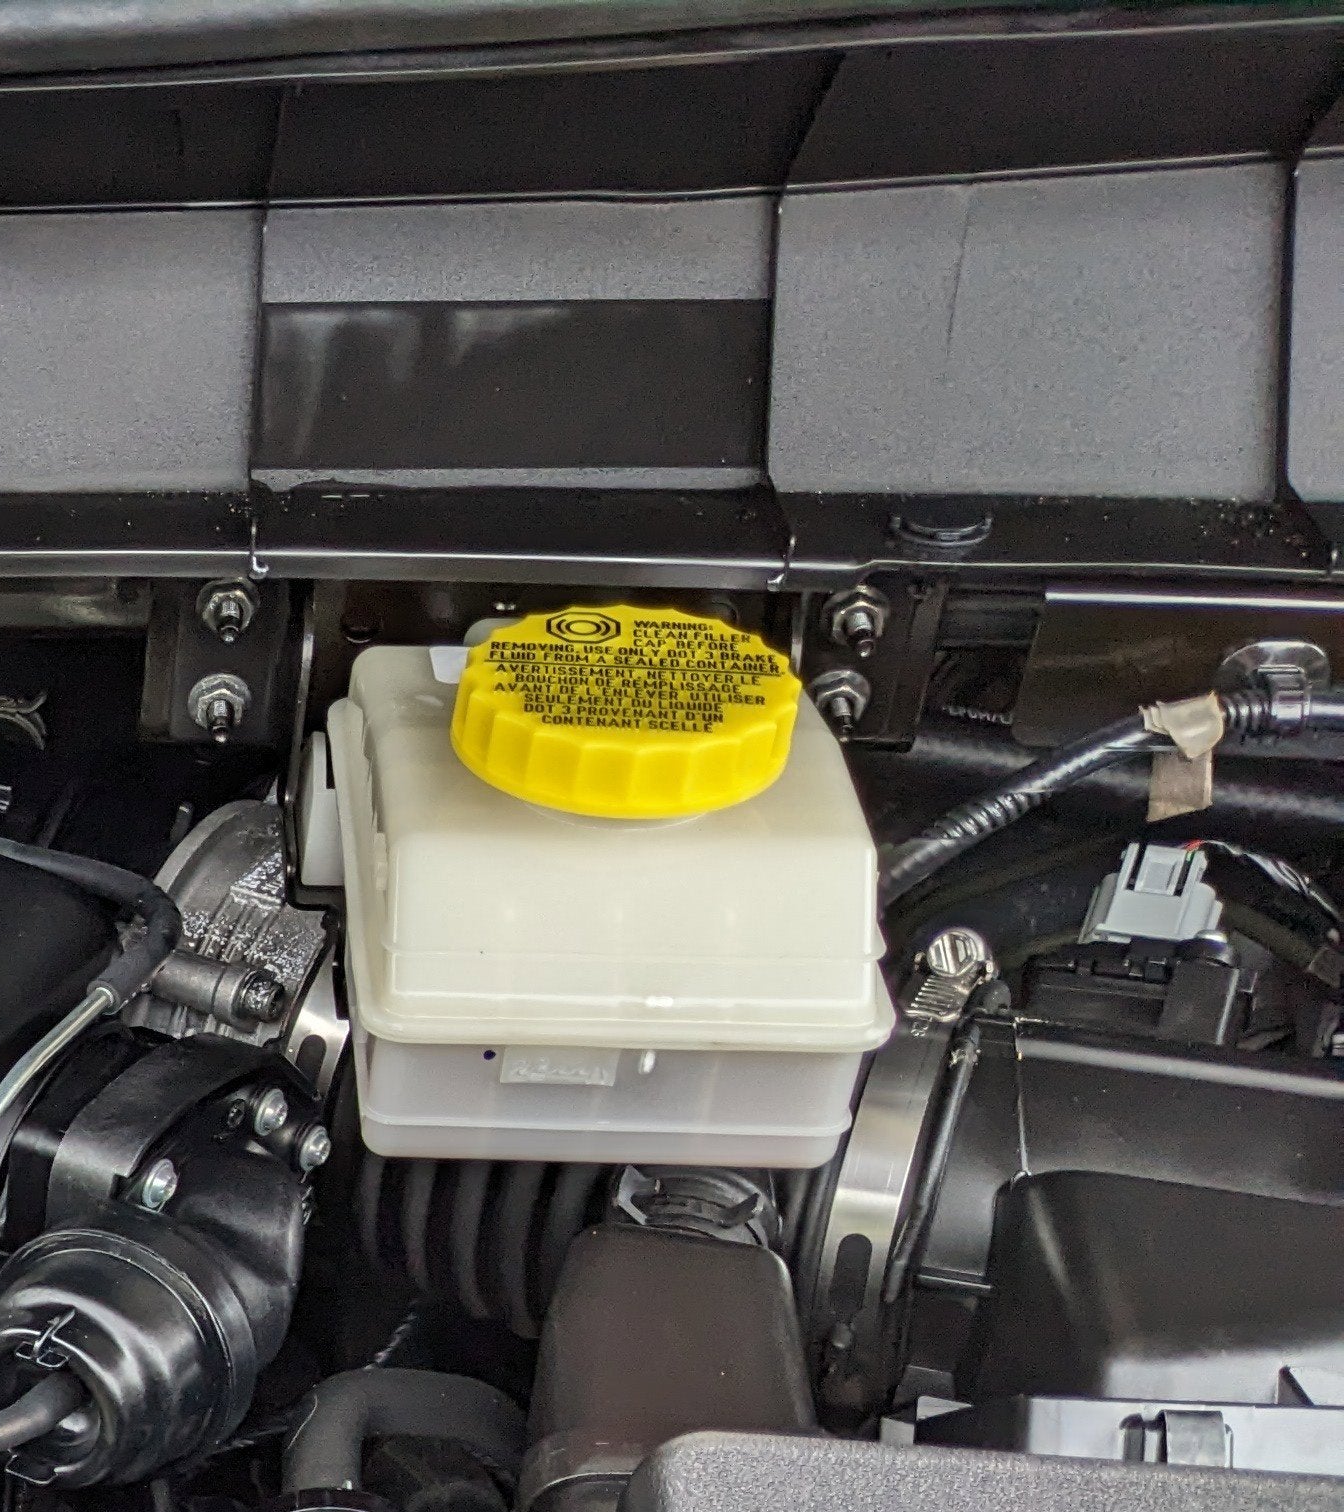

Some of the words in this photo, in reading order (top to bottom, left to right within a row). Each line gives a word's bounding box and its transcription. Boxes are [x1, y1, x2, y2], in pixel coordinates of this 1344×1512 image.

[634, 620, 713, 631] WARNING:
[633, 629, 688, 640] CLEAN
[694, 632, 750, 643] FILLER
[634, 639, 666, 648] CAP
[677, 640, 739, 651] BEFORE
[489, 651, 536, 661] FLUID
[543, 652, 589, 663] FROM
[596, 655, 606, 664] A
[614, 656, 680, 667] SEALED
[583, 645, 613, 655] USE
[618, 648, 660, 657] ONLY
[668, 650, 696, 659] DOT
[705, 651, 714, 660] 3
[720, 652, 777, 663] BRAKE
[516, 674, 589, 686] BOUCHON
[595, 678, 613, 687] DE
[622, 679, 741, 694] REMPLISSAGE
[647, 671, 734, 683] NETTOYER
[741, 675, 761, 685] LE
[494, 682, 551, 693] AVANT
[559, 685, 579, 695] DE
[689, 693, 765, 705] UTILISER
[524, 693, 622, 708] SEULEMENT
[631, 699, 652, 709] DU
[659, 700, 723, 713] LIQUIDE
[524, 703, 553, 713] DOT
[562, 706, 571, 714] 3
[577, 707, 677, 719] PROVENANT
[542, 715, 642, 728] CONTENANT
